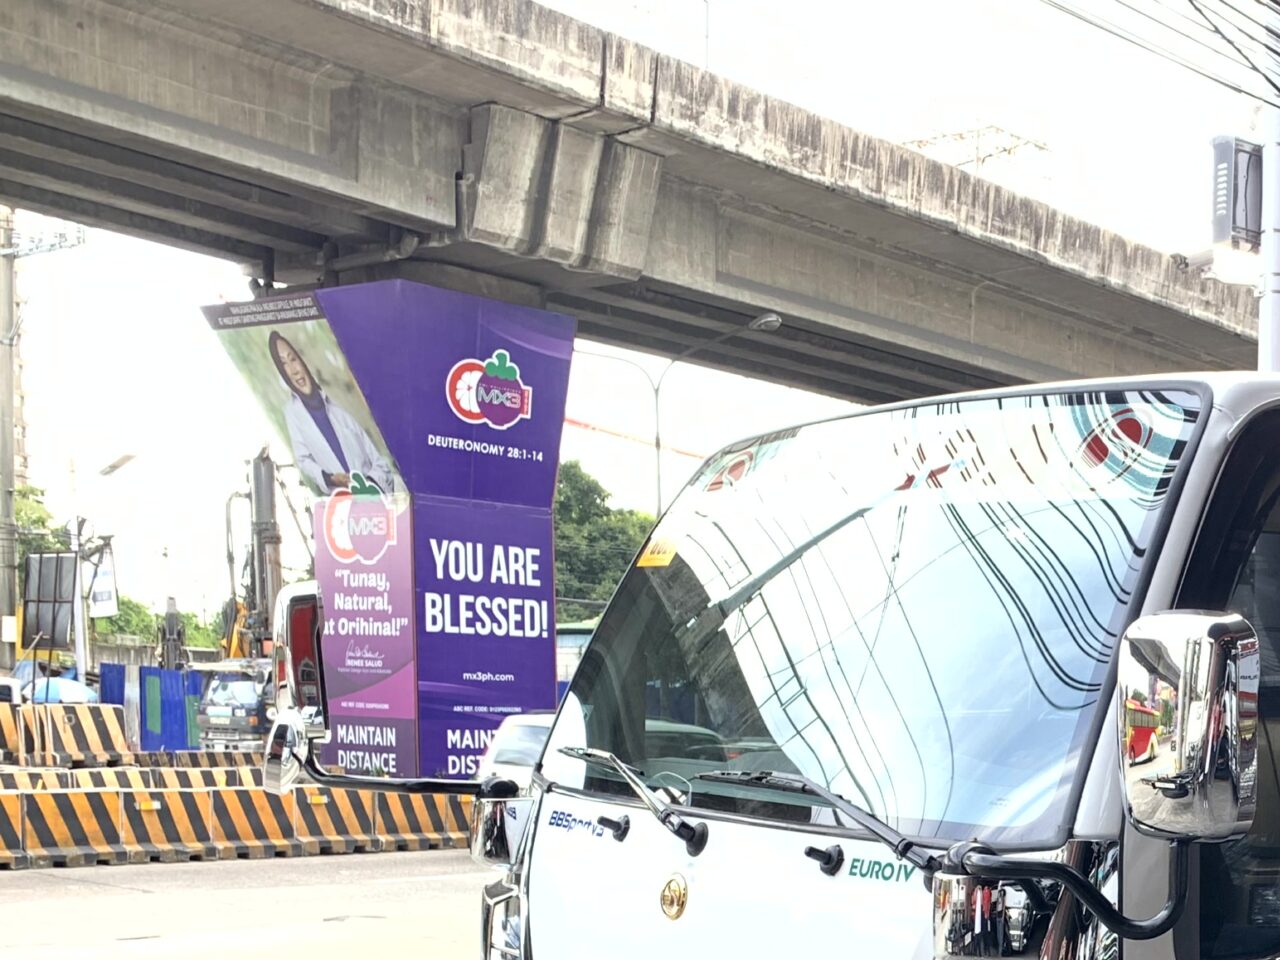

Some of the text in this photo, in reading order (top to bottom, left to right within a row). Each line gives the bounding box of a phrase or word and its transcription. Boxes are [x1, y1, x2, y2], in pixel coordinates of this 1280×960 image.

[477, 387, 521, 408] MX3
[428, 434, 543, 462] DEUTERONOMY 28:1-14
[349, 516, 388, 536] MX3
[429, 538, 541, 587] YOU ARE
[334, 592, 392, 615] Natural,
[425, 592, 548, 639] BLESSED!
[462, 671, 515, 682] mx3ph.com
[337, 725, 396, 746] MAINTAIN
[446, 729, 499, 749] MAIN
[338, 750, 397, 773] DISTANCE
[848, 858, 917, 882] EURO IV
